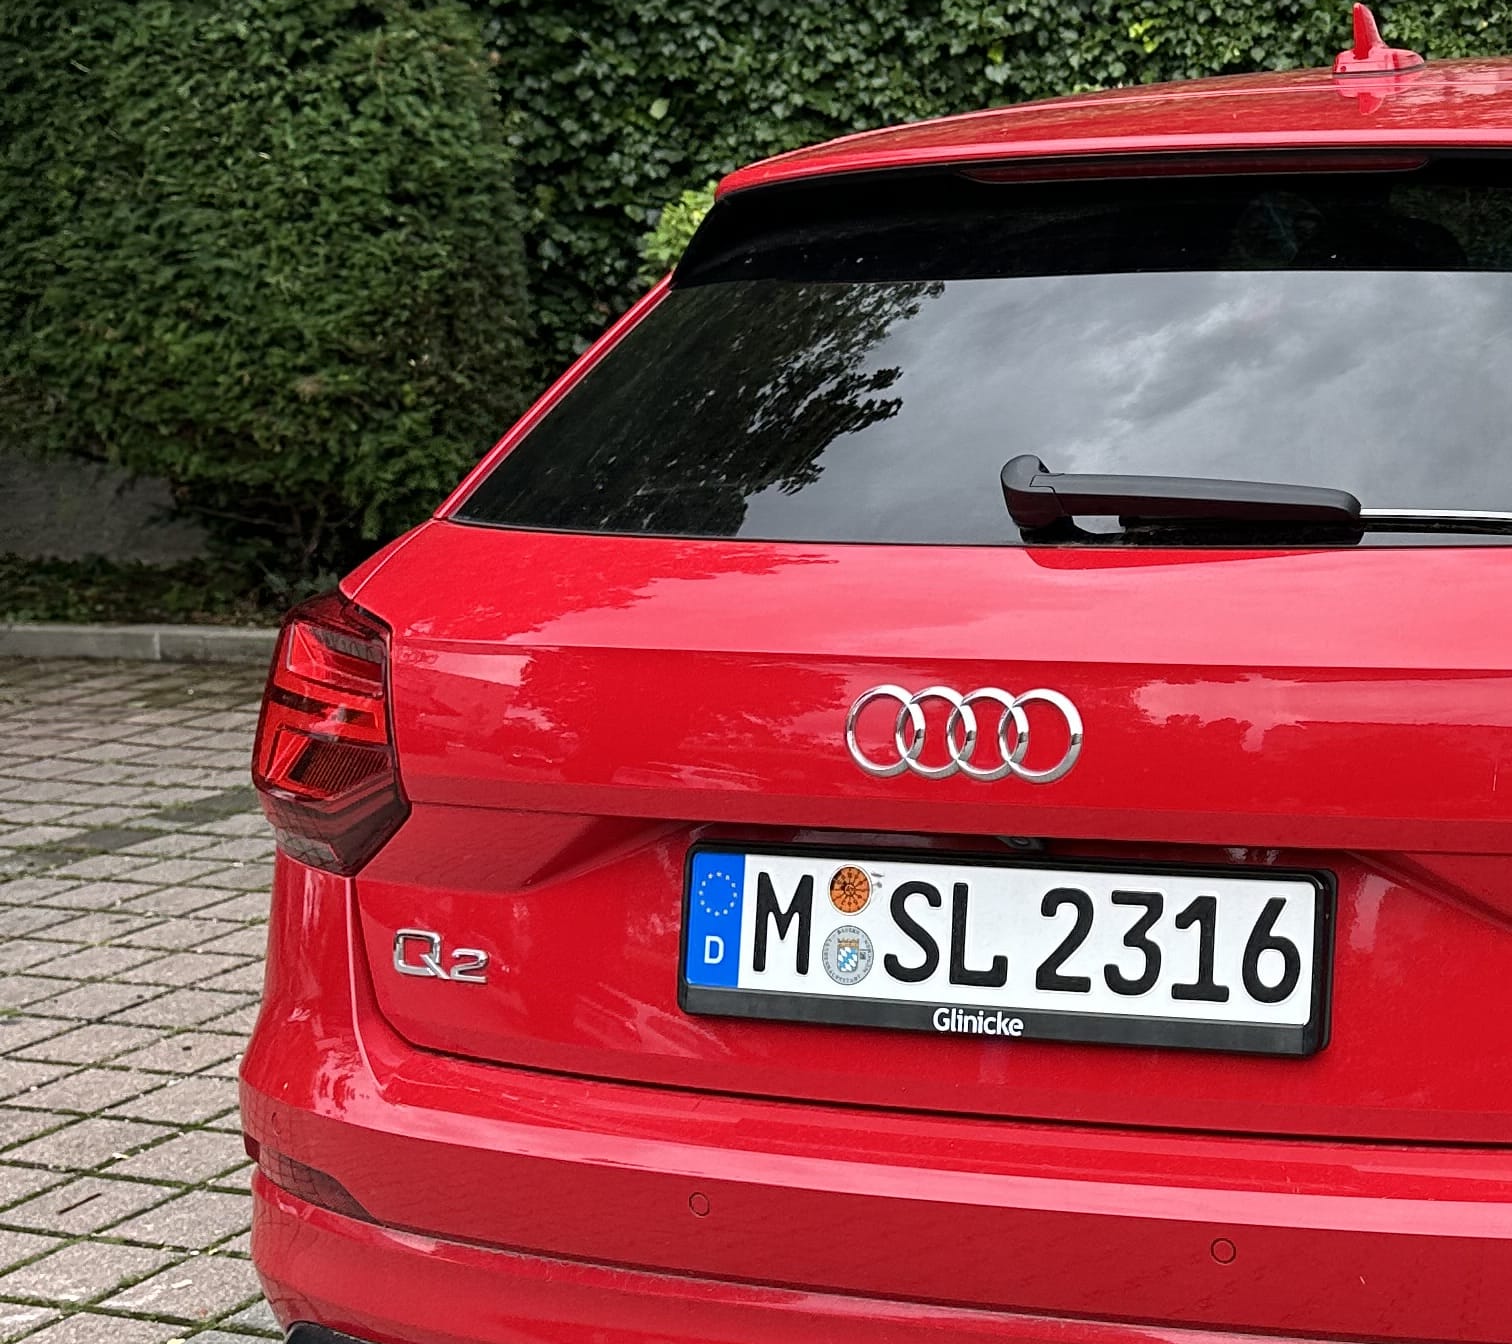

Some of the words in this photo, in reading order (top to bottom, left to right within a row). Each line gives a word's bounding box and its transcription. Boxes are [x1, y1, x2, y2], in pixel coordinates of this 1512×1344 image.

[393, 927, 490, 984] Q2
[703, 934, 725, 965] D
[752, 871, 813, 976] M
[883, 880, 1008, 988] SL
[1034, 887, 1301, 1004] 2316
[933, 1006, 1024, 1037] Glinicke
